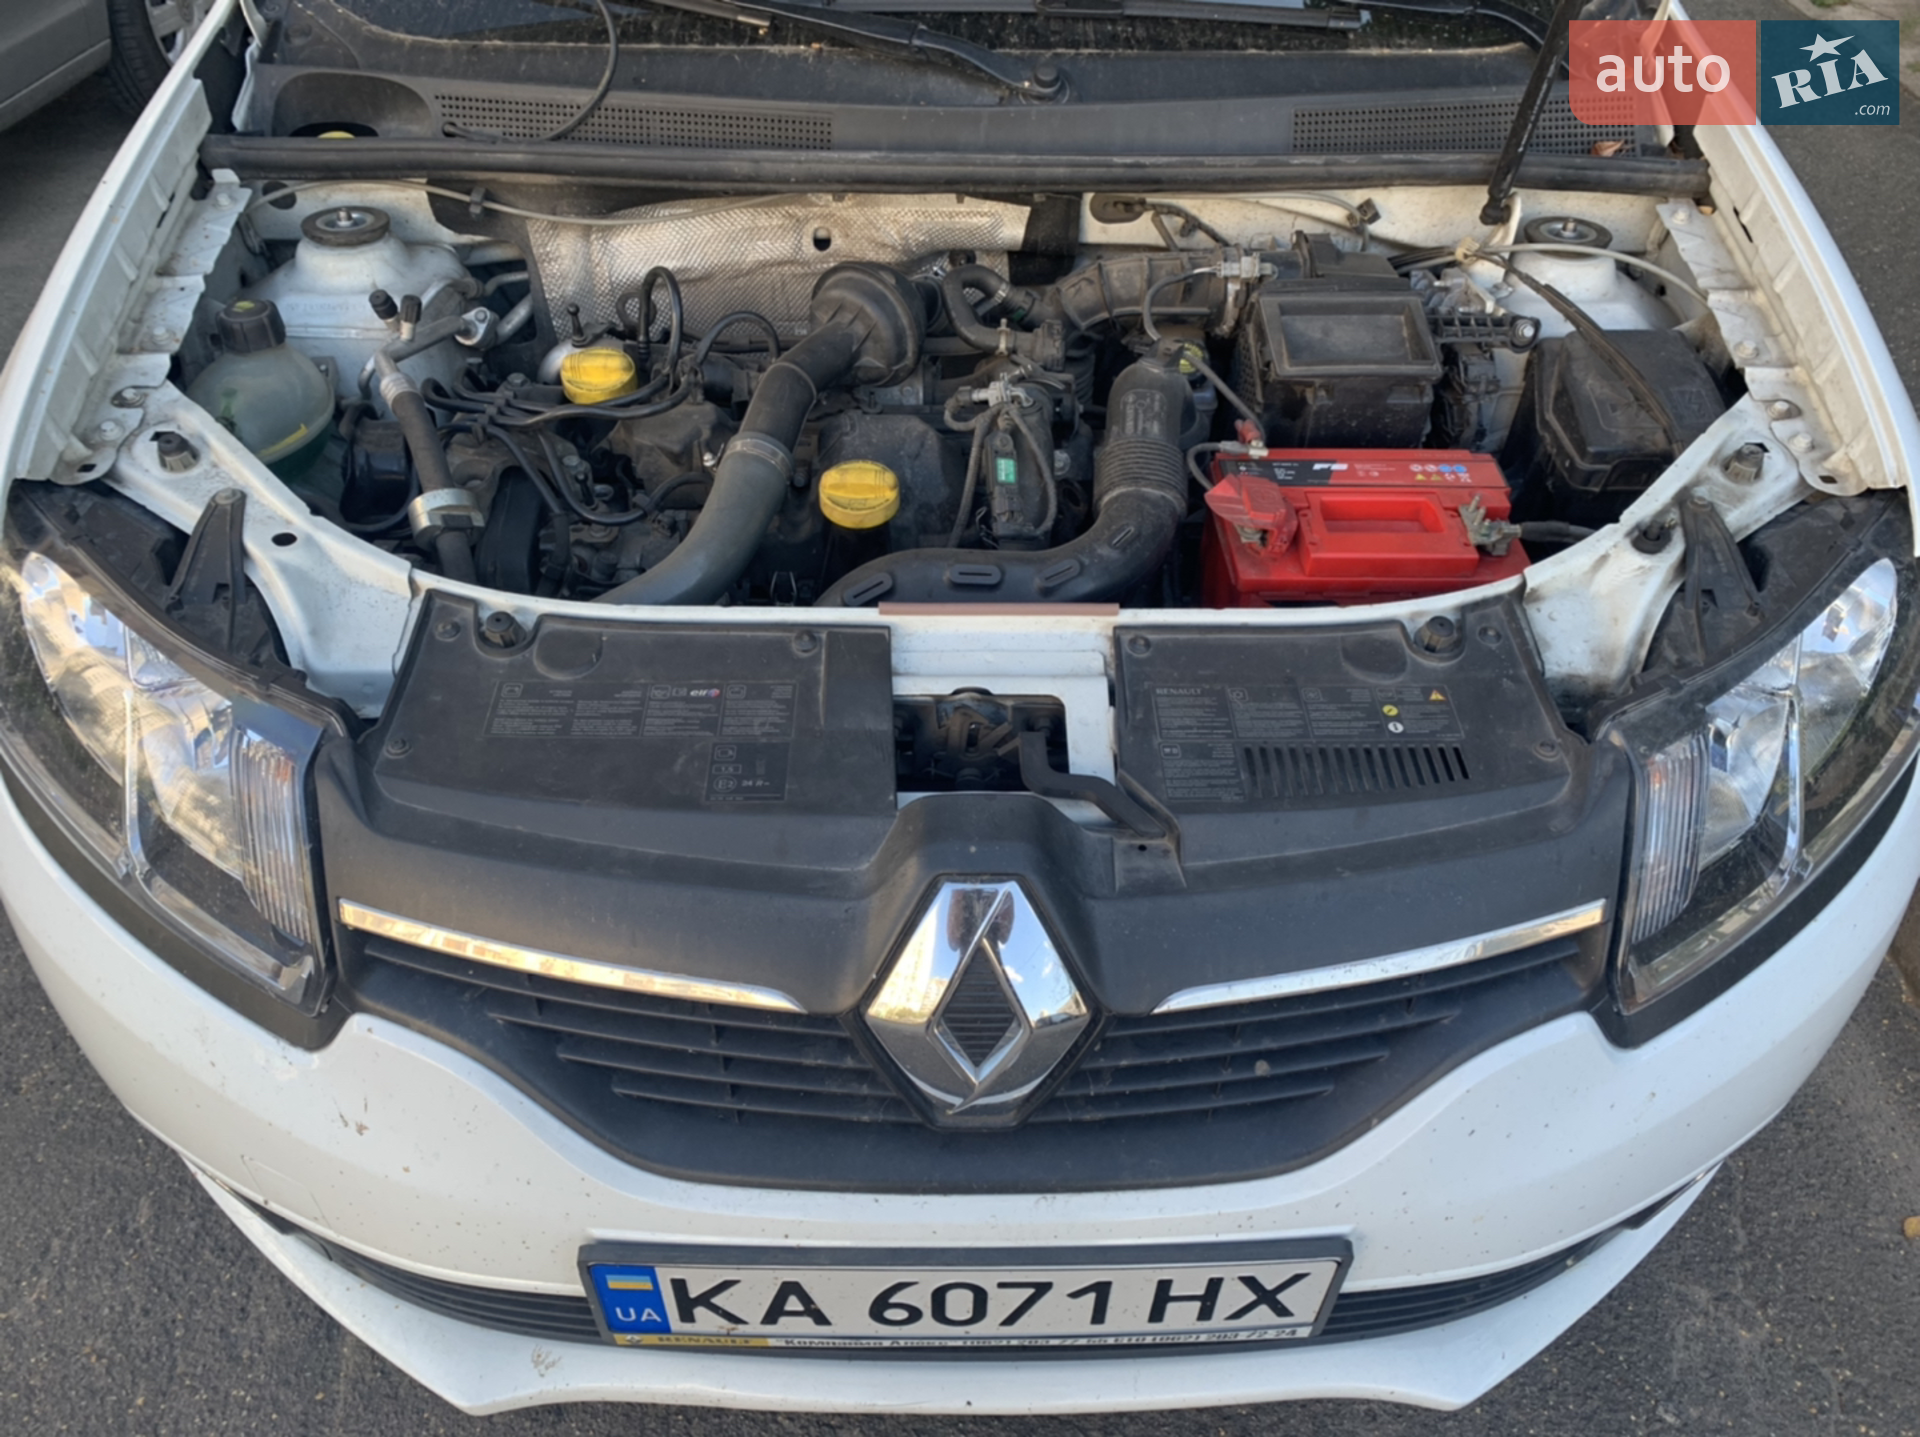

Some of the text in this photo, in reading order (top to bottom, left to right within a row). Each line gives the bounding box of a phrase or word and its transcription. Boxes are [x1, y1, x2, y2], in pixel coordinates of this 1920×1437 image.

[1155, 687, 1202, 695] RENAULT
[670, 1272, 1312, 1327] KA 6071 HX
[615, 1306, 662, 1323] UA
